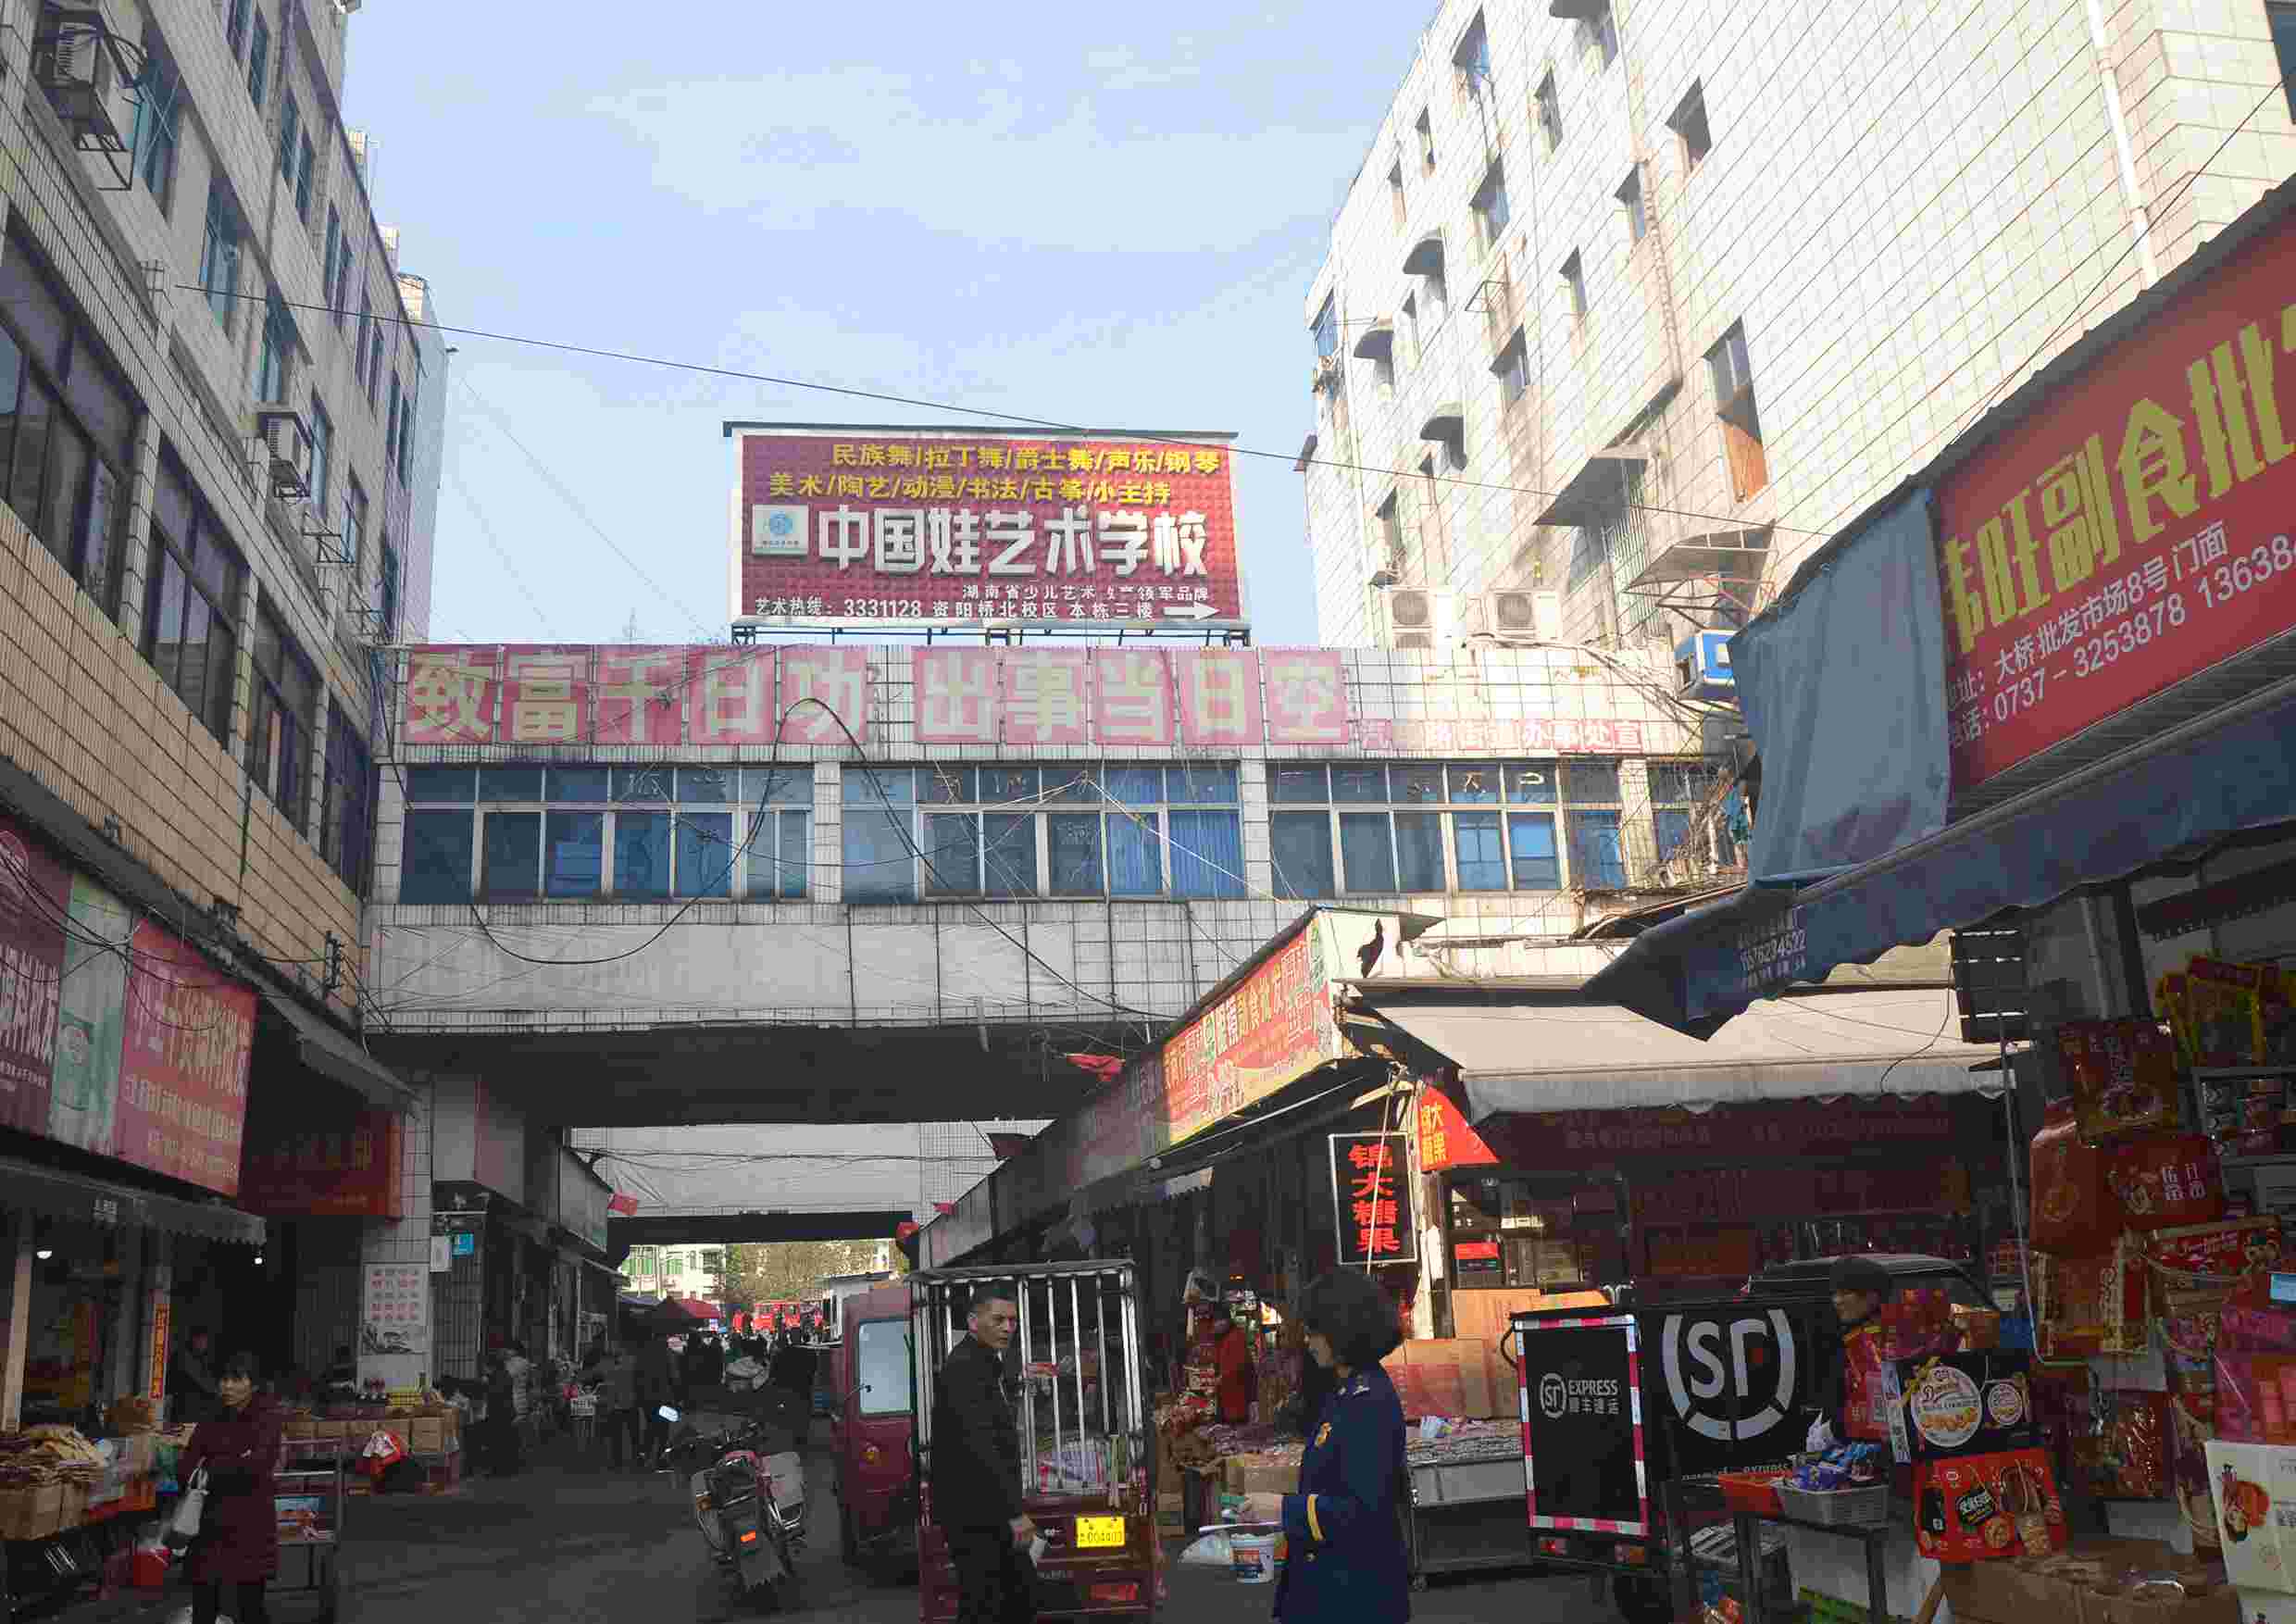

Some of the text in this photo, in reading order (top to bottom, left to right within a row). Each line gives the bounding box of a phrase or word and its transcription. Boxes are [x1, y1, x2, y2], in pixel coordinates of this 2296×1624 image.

[1942, 302, 2296, 654] 旺副食批
[818, 506, 1207, 576] 中国娃艺术学校
[2197, 531, 2296, 608] 13638
[843, 599, 922, 617] 3331128
[1994, 519, 2228, 684] 大桥批发市场8号门面
[407, 649, 1342, 743] 致富千日功 出事当日空
[1567, 1379, 1619, 1396] EXPRESS
